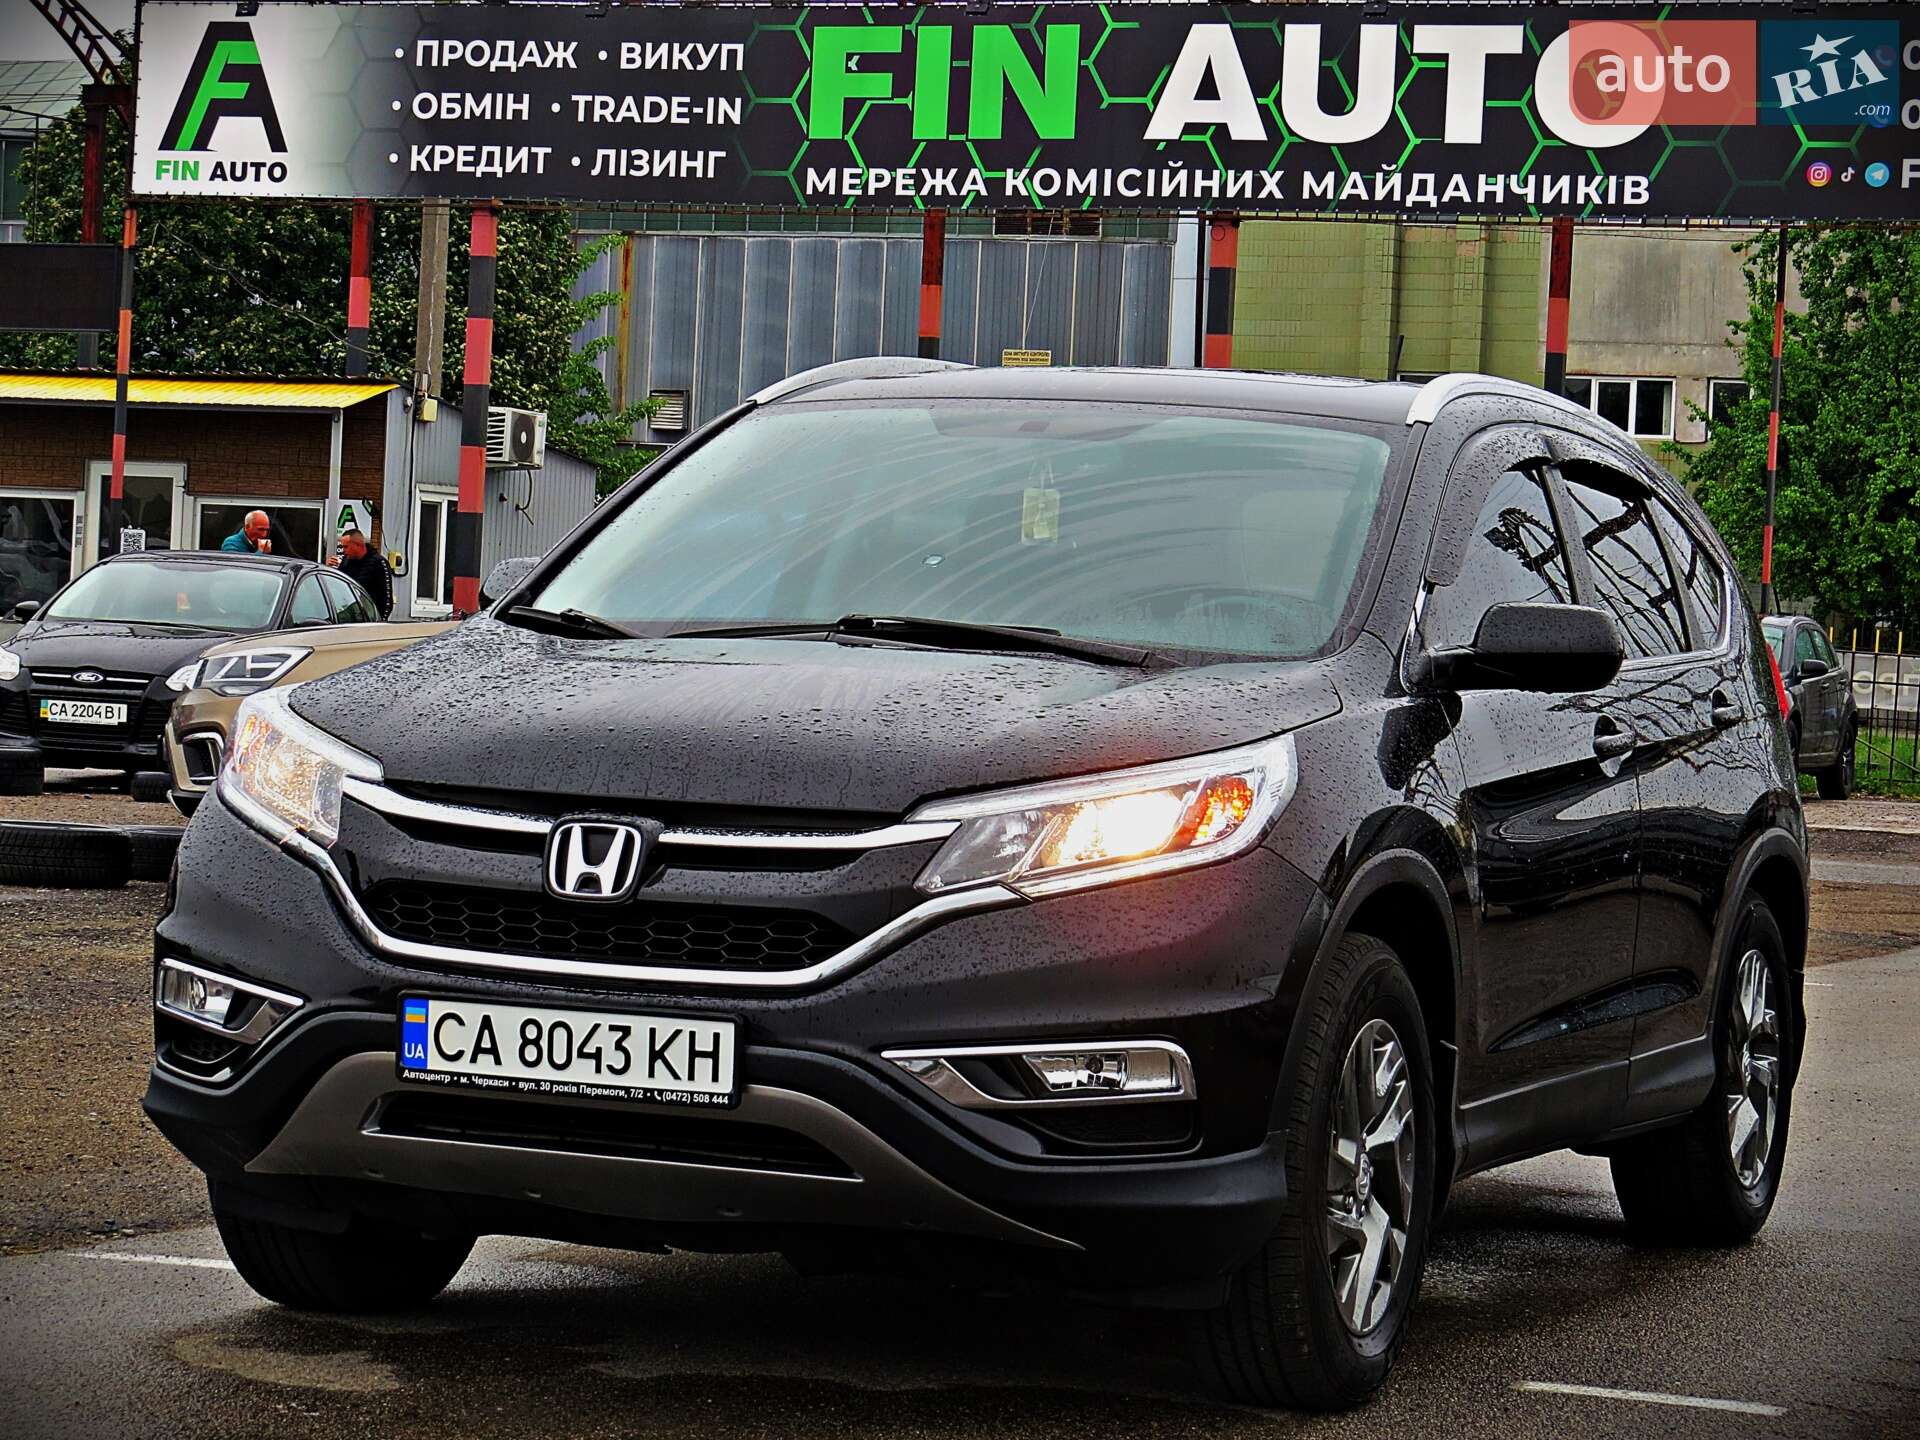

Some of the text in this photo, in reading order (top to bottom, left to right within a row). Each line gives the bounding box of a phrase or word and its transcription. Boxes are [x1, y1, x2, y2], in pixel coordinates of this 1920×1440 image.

[415, 40, 744, 73] ПРОДАЖ ВИКУП
[808, 22, 1668, 149] FIN AUTO
[411, 92, 742, 125] ОБМІН TRADE-IN
[155, 159, 288, 183] FIN AUTO
[409, 145, 727, 178] КРЕДИТ ЛІЗИНГ
[805, 161, 1651, 208] МЕРЕЖА КОМІСІЙНИХ МАЙДАНЧИКІВ
[49, 703, 68, 717] CA
[71, 704, 102, 719] 2204
[404, 1043, 425, 1059] UA
[433, 1011, 721, 1083] CA 8043 KH
[403, 1069, 729, 1104] Автоцентр м. Черкаси вул. 30 років Перемоги, 7/2 (0472) 508 444
